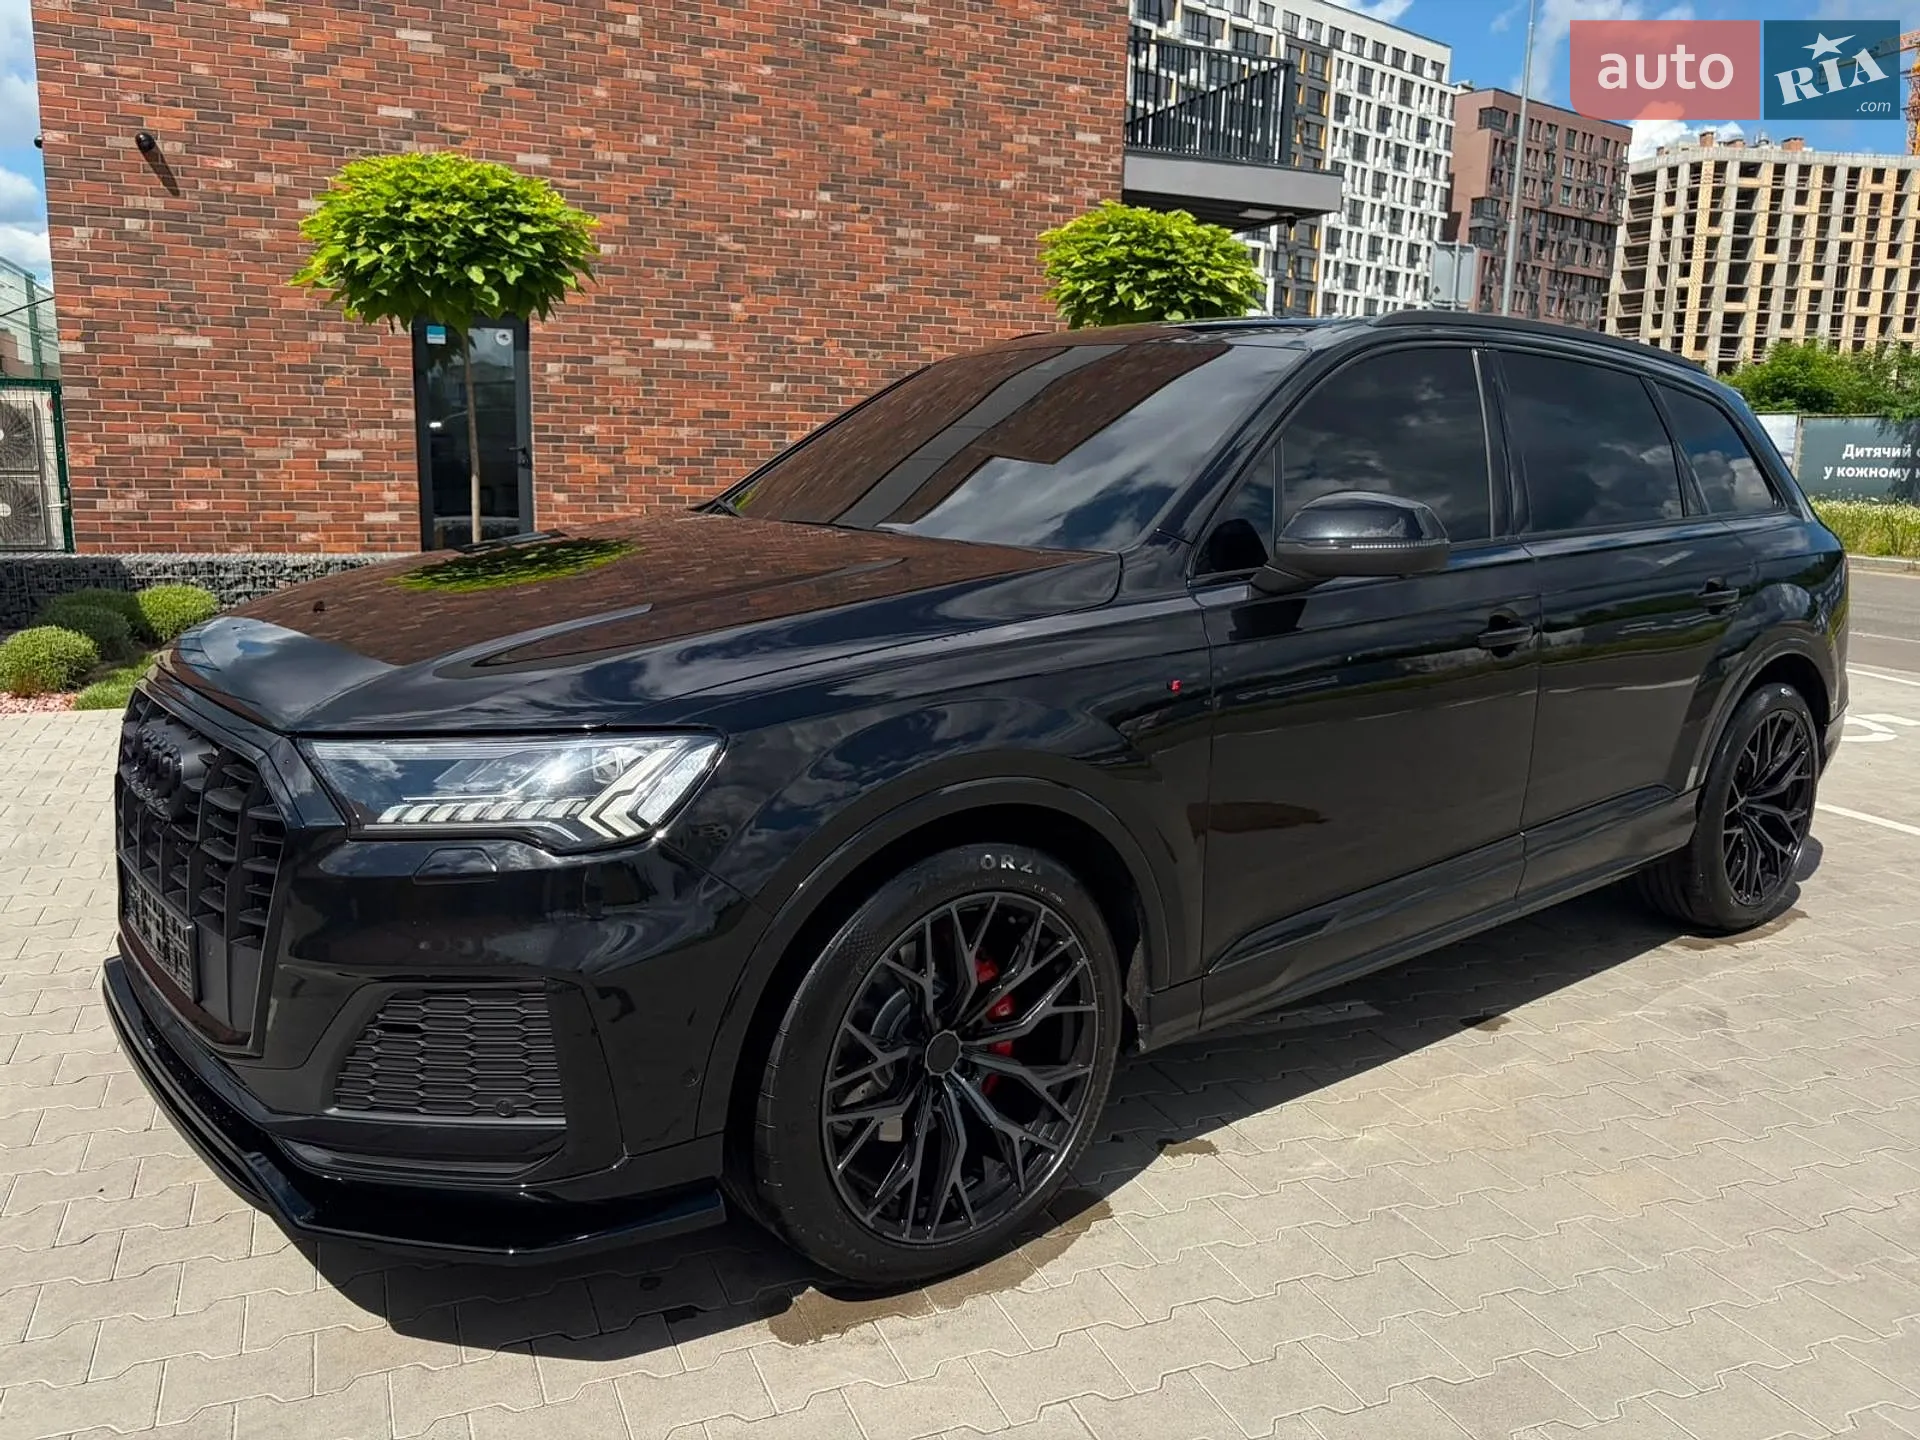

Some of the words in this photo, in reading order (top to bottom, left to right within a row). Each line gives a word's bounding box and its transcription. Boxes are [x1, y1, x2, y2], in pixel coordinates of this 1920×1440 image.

[1842, 444, 1912, 460] Дитячий
[1823, 466, 1833, 480] у
[1836, 466, 1911, 482] кожному
